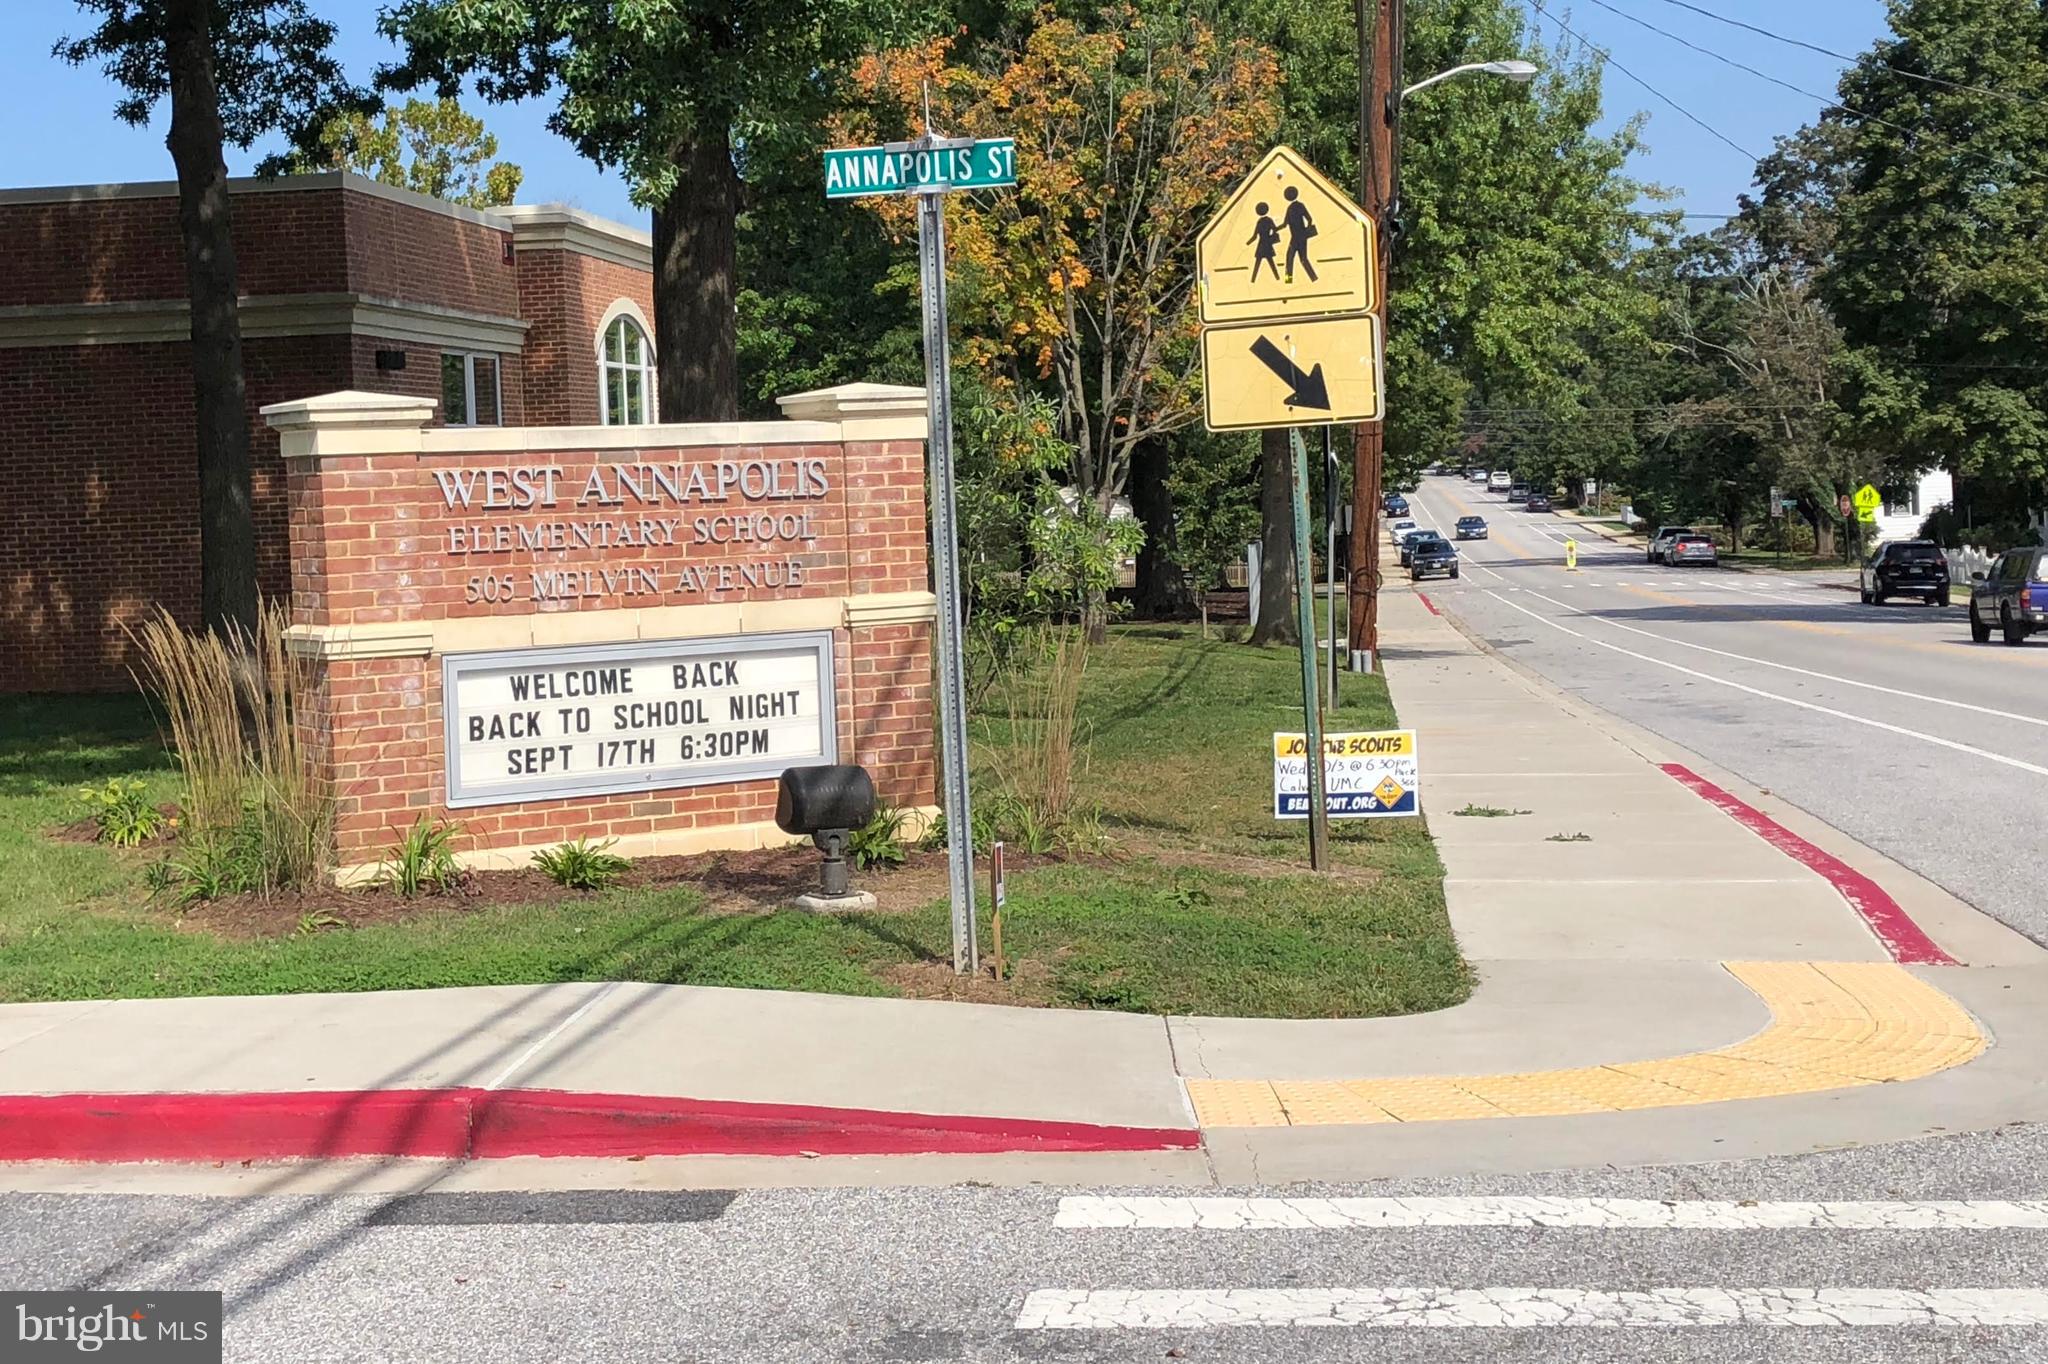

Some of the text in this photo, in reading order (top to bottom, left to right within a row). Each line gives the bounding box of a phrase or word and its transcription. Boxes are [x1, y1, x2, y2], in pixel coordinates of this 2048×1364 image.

[827, 146, 1014, 188] ANNAPOLIS ST
[433, 460, 829, 510] WEST ANNAPOLIS
[448, 514, 817, 555] ELEMENTARY SCHOOL
[466, 561, 806, 602] 505 MELVIN AVENUE
[509, 660, 740, 701] WELCOME BACK
[468, 691, 800, 741] BACK TO SCHOOL NIGHT
[508, 729, 769, 775] SEPT 17TH 6:30PM
[1286, 739, 1309, 754] JO
[1350, 737, 1402, 753] SCOUTS
[1350, 760, 1362, 771] @
[1288, 796, 1377, 811] BEAOUT.ORG
[1331, 777, 1363, 791] UMC
